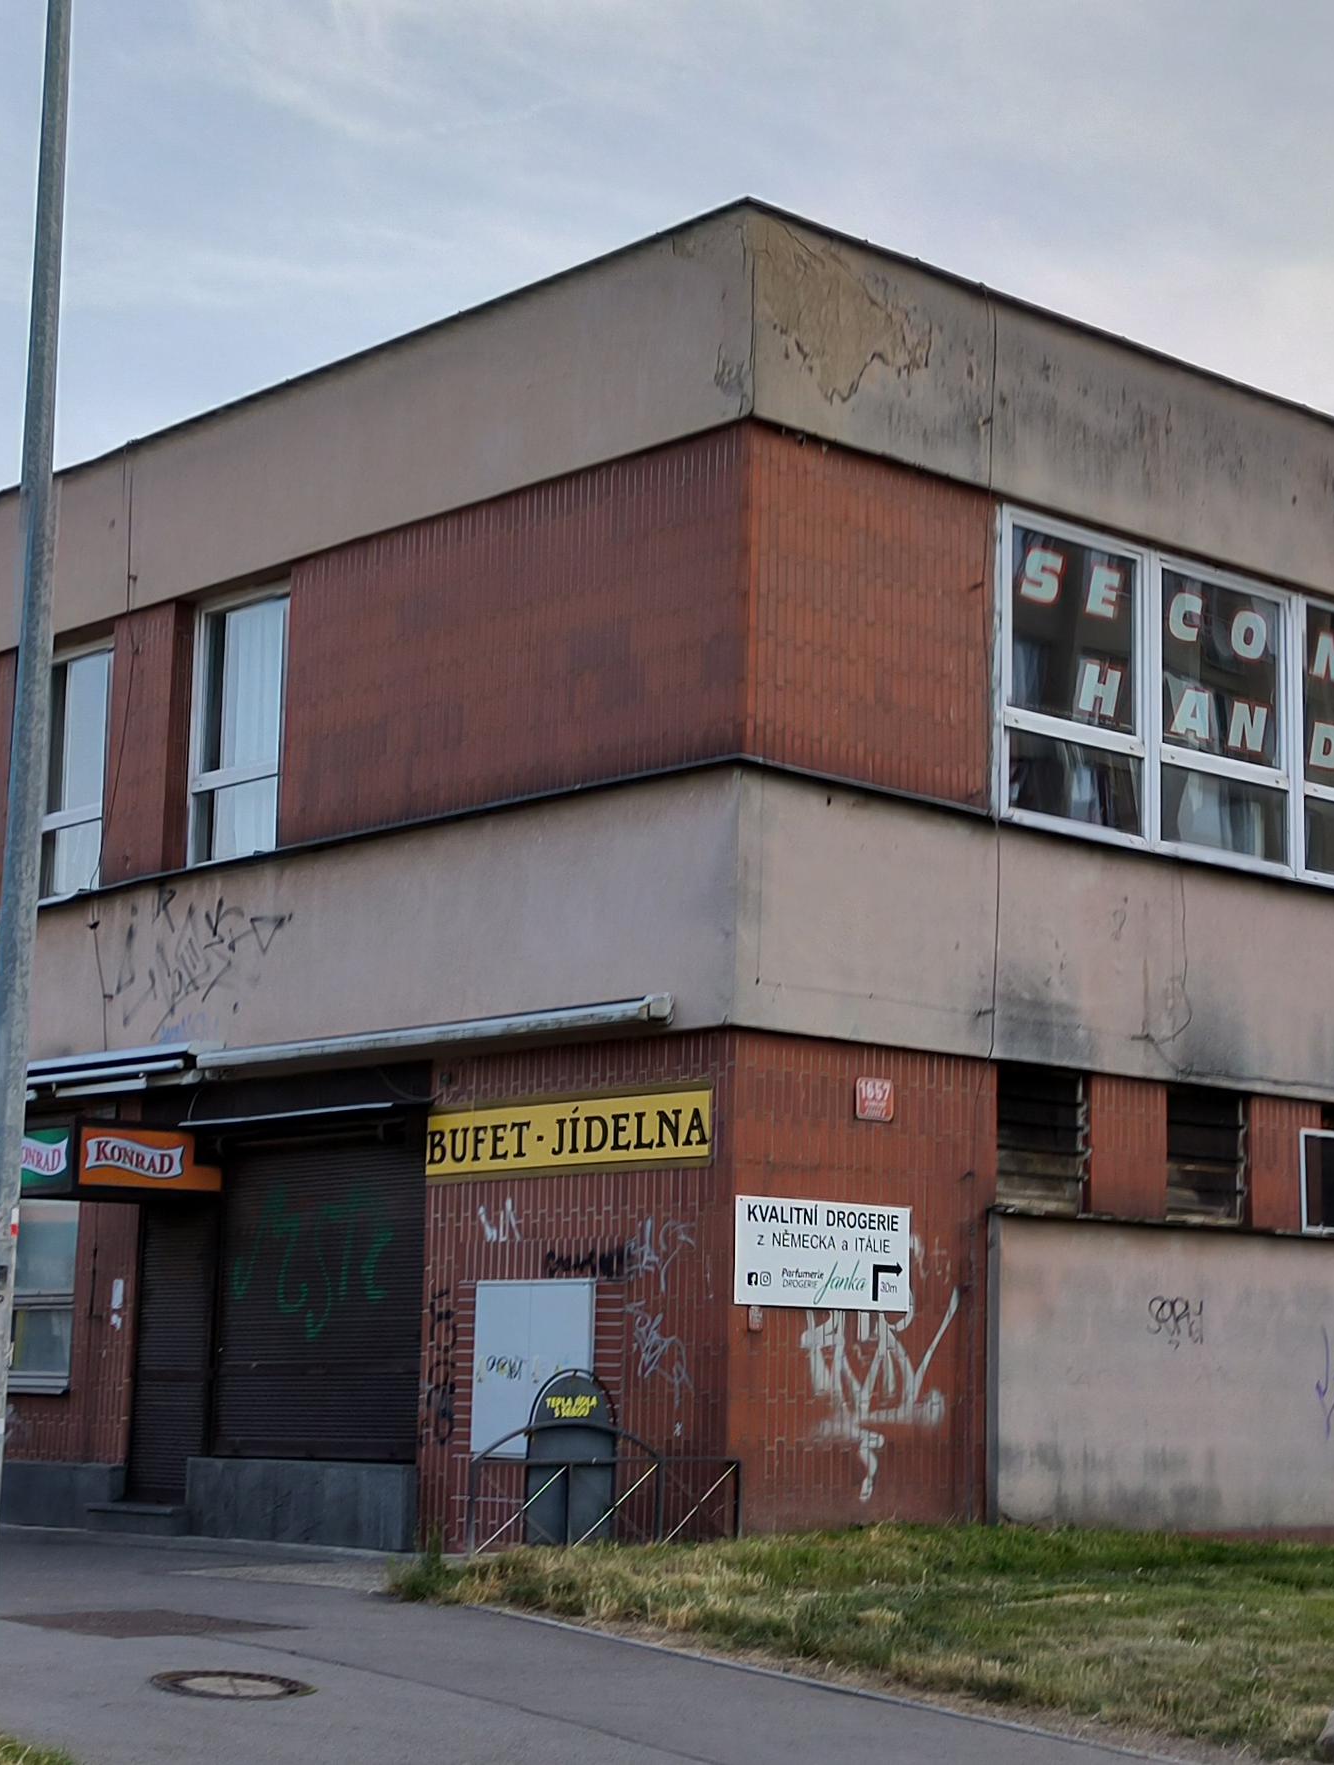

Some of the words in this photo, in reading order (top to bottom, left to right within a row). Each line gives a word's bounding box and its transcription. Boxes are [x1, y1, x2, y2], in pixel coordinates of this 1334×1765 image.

[427, 1120, 531, 1165] BUFET
[551, 1106, 711, 1155] JÍDELNA
[21, 1145, 62, 1172] ONRAD
[94, 1140, 174, 1175] KONRAD
[748, 1204, 818, 1226] KVALITNÍ
[826, 1210, 899, 1232] DROGERIE
[772, 1229, 836, 1250] NĚMECKA
[841, 1239, 849, 1251] a
[855, 1235, 891, 1254] ITÁLIE
[781, 1267, 825, 1281] Parfumerie
[782, 1279, 818, 1289] DROGERIE
